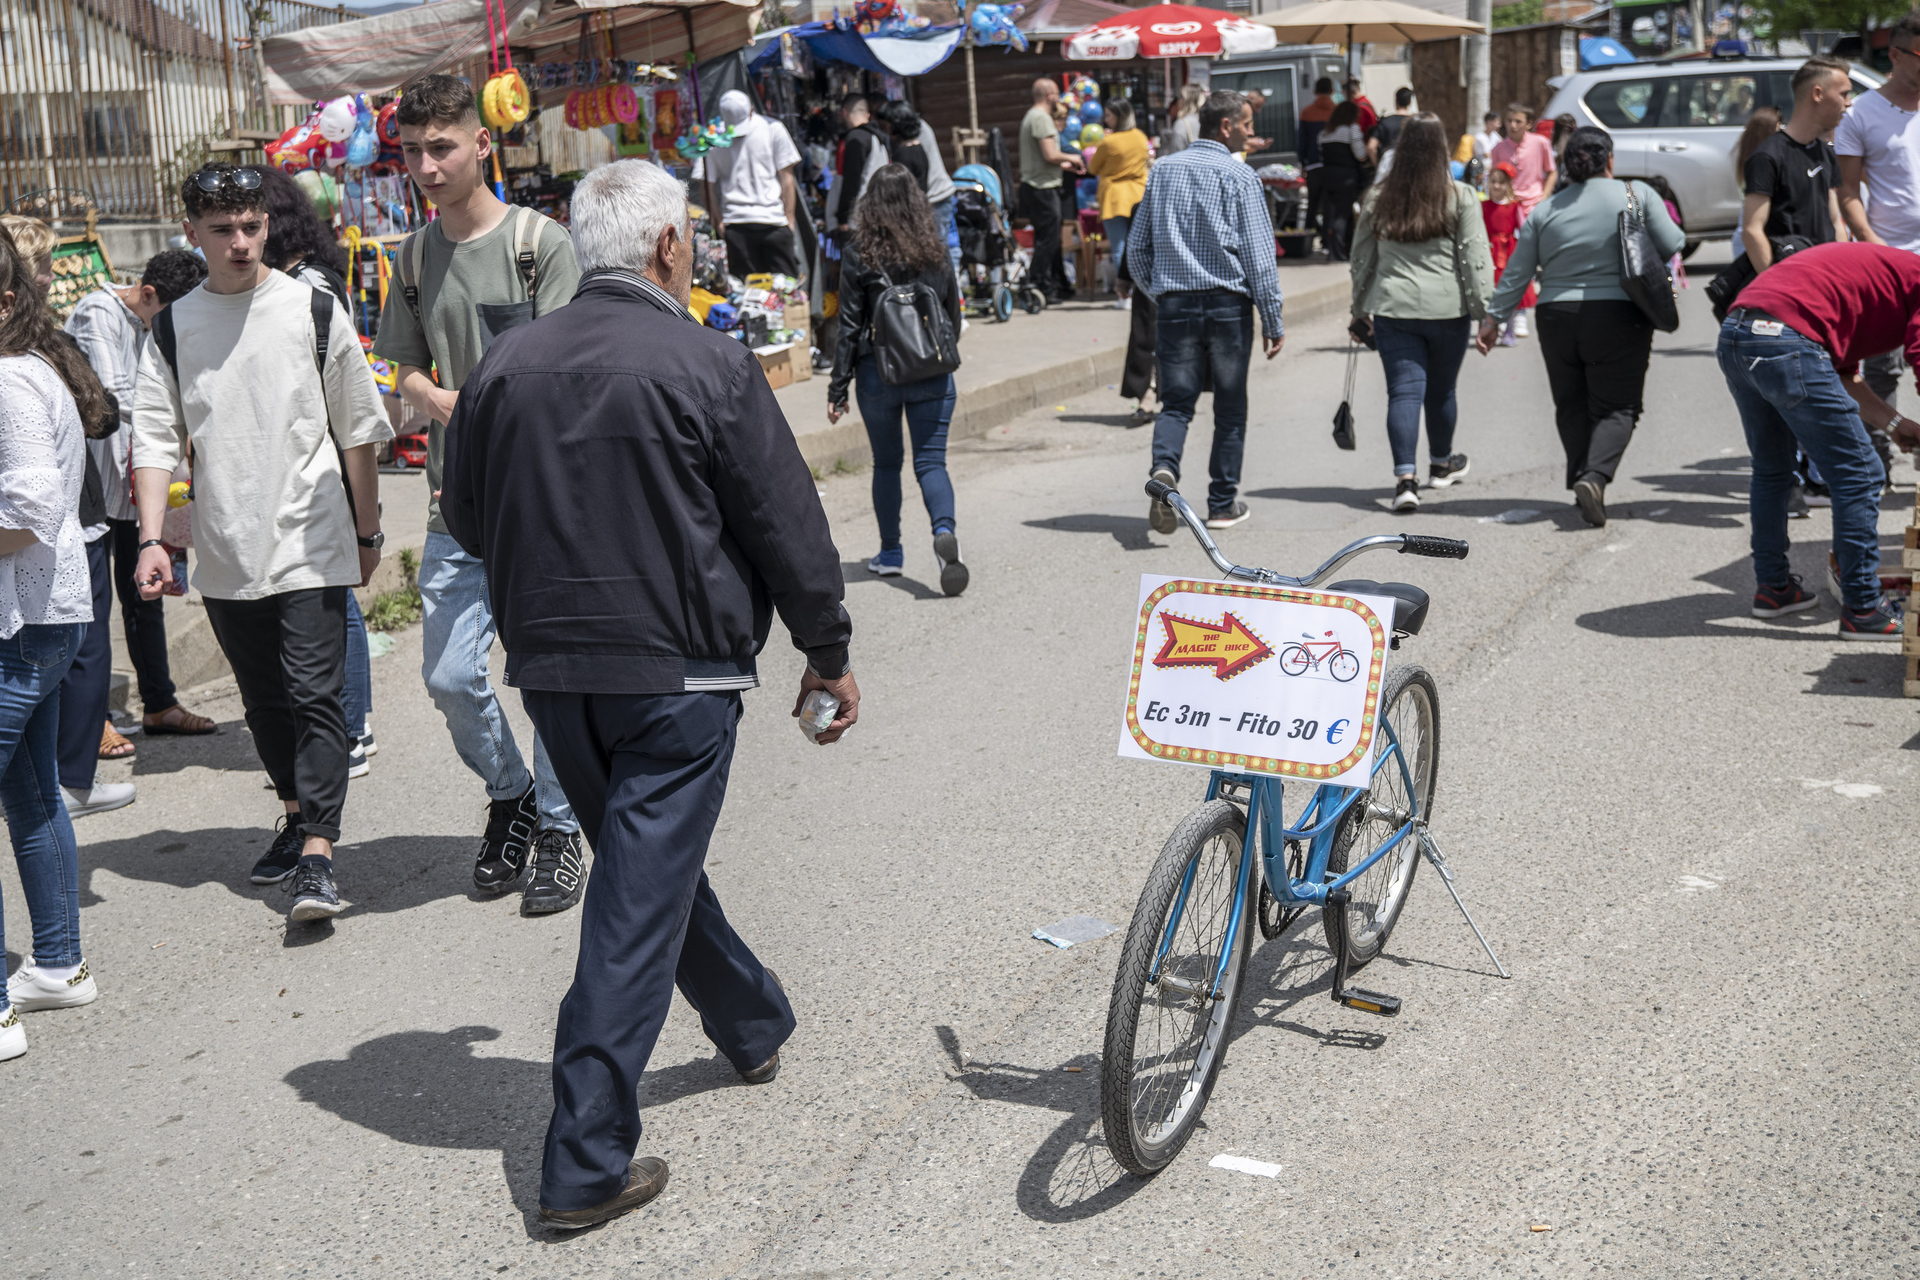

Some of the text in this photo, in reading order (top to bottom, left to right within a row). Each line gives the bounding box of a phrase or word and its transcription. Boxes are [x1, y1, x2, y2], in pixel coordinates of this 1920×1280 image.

[1203, 633, 1220, 641] THE
[1174, 643, 1250, 655] MAGIC BIKE
[1143, 700, 1170, 722] Ec
[1174, 704, 1211, 727] 3m
[1236, 711, 1281, 736] Fito
[1287, 718, 1319, 741] 30
